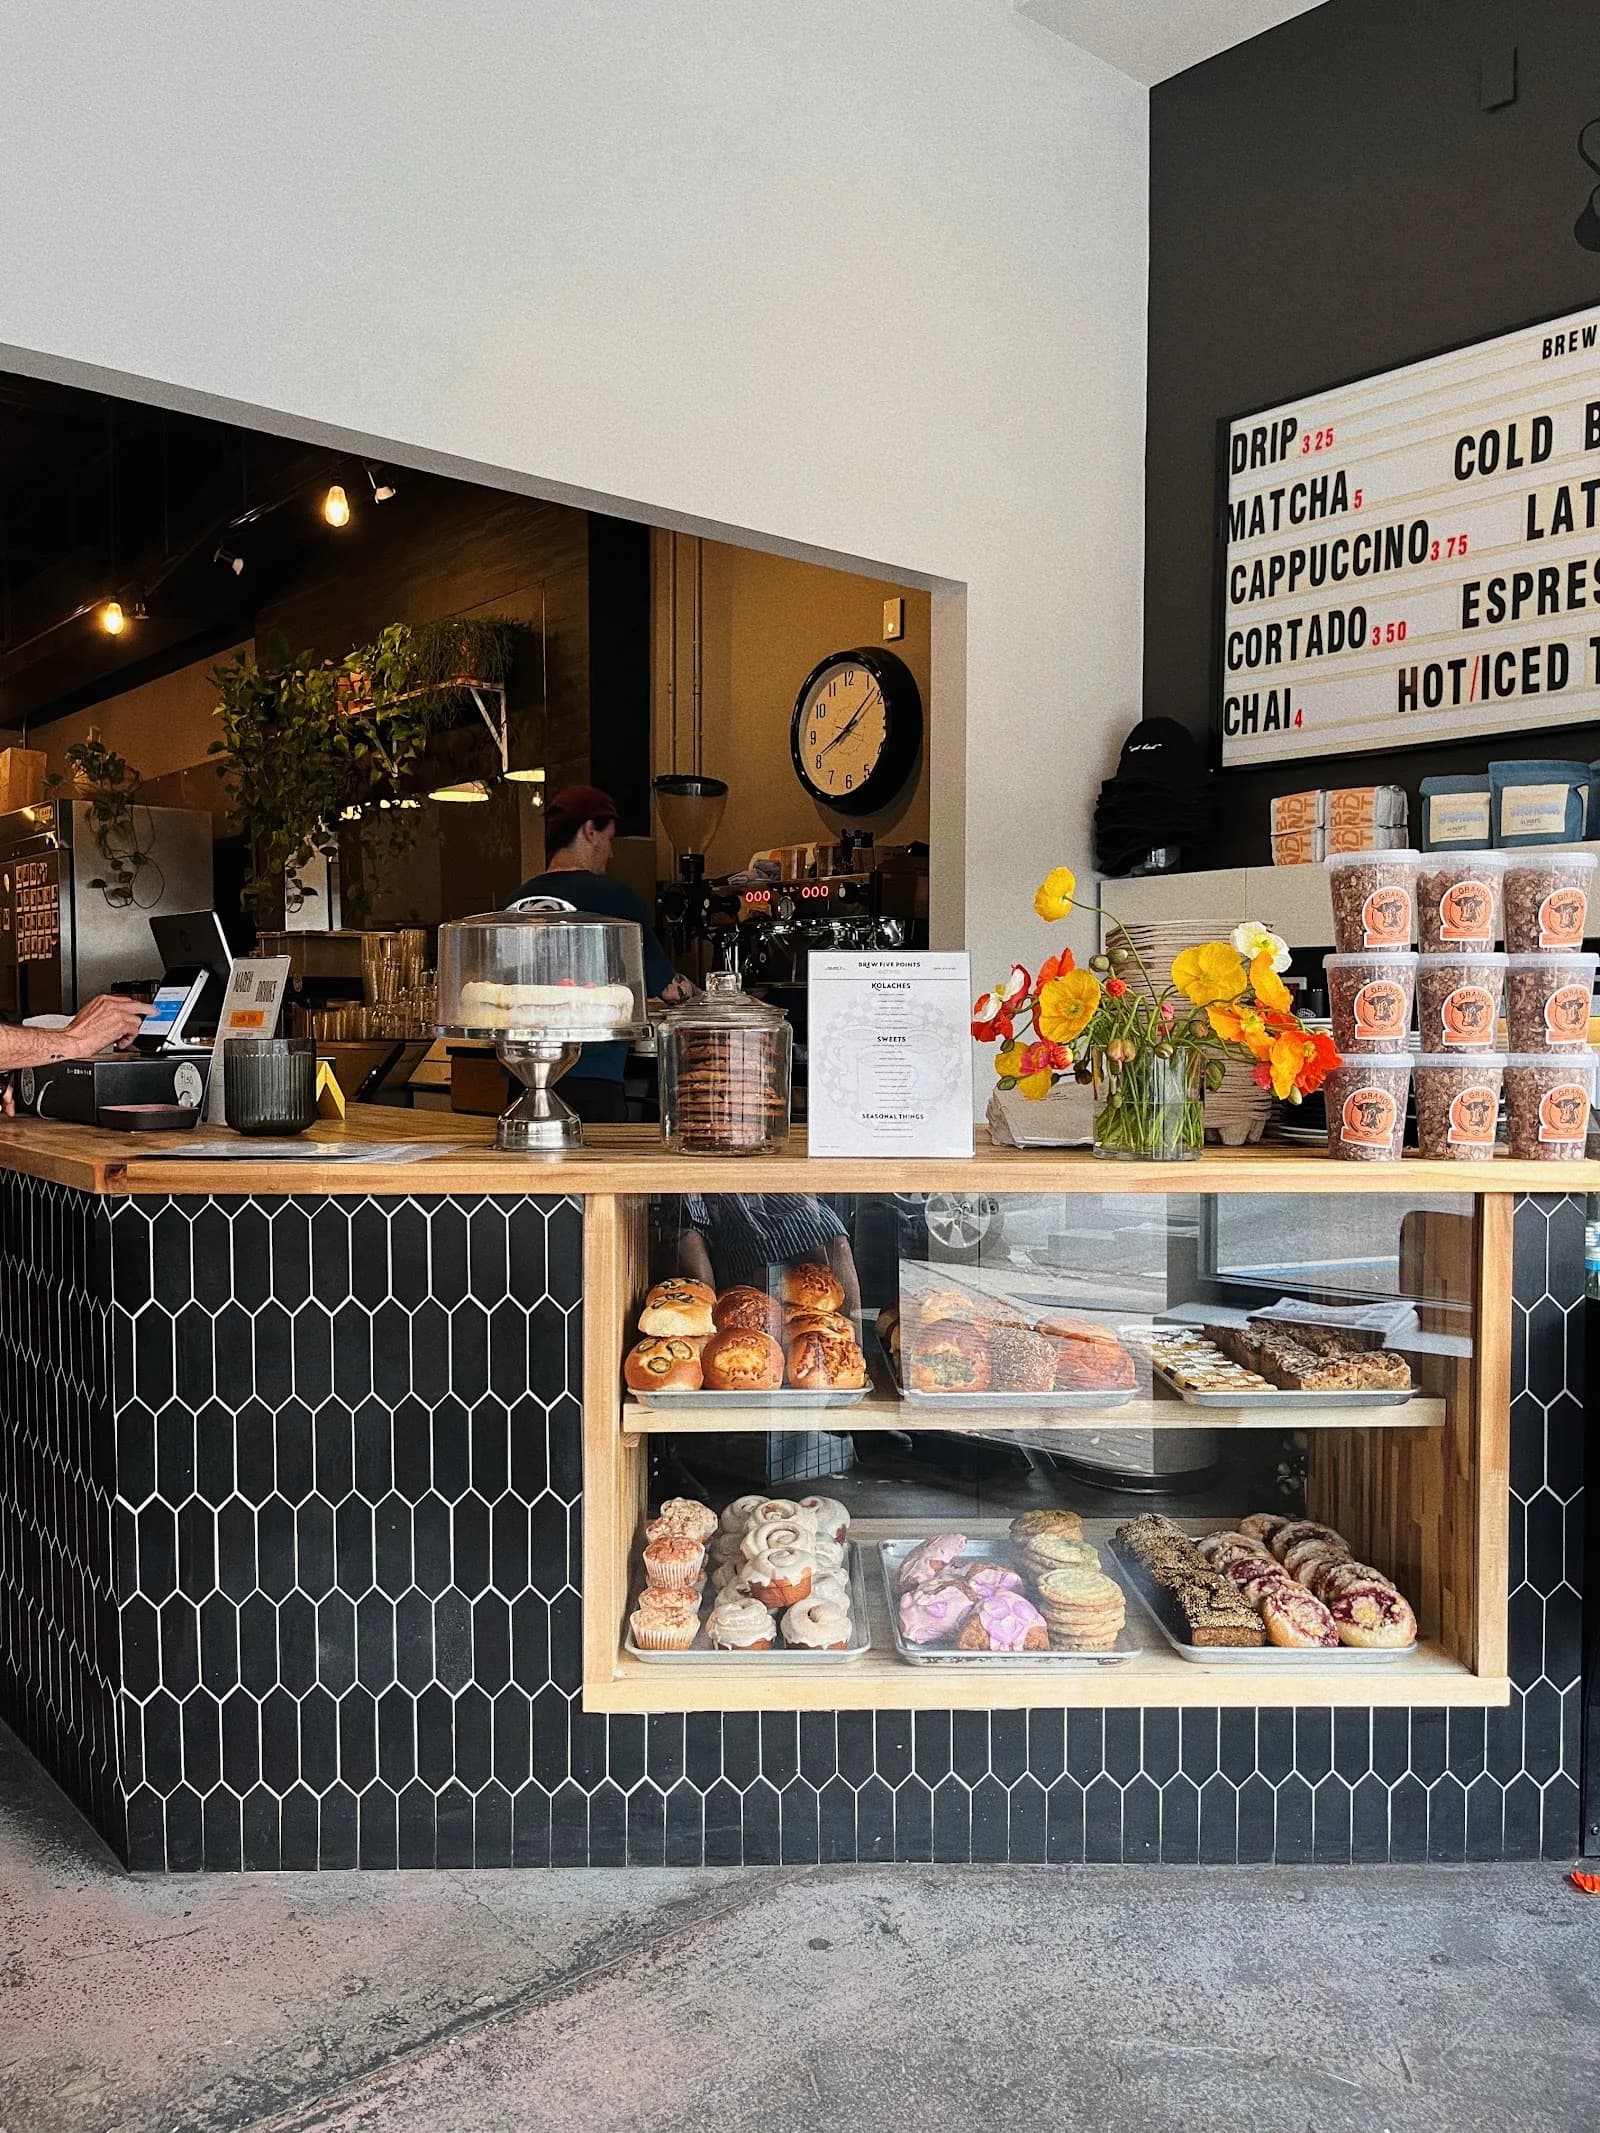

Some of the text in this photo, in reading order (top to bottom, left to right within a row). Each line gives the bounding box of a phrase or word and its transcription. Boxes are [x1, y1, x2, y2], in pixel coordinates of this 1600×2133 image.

[1542, 324, 1598, 360] BREW
[1232, 417, 1297, 475] DRIP
[1454, 415, 1553, 480] COLD
[1226, 470, 1364, 544] MATCHA 5
[1527, 479, 1600, 541] LAT
[1230, 519, 1429, 605] CAPPUCCINO
[1227, 606, 1367, 670] CORTADO
[844, 670, 854, 687] 12
[866, 674, 870, 690] 1
[1398, 643, 1569, 712] HOT/ICED
[828, 682, 836, 697] 11
[816, 703, 826, 719] 10
[1224, 688, 1303, 736] CHAI 4
[810, 731, 817, 745] 9
[815, 754, 822, 770] 8
[828, 770, 835, 785] 7
[863, 765, 870, 780] 5
[845, 774, 852, 789] 6
[858, 961, 878, 969] BREW
[871, 982, 911, 991] KOLACHES
